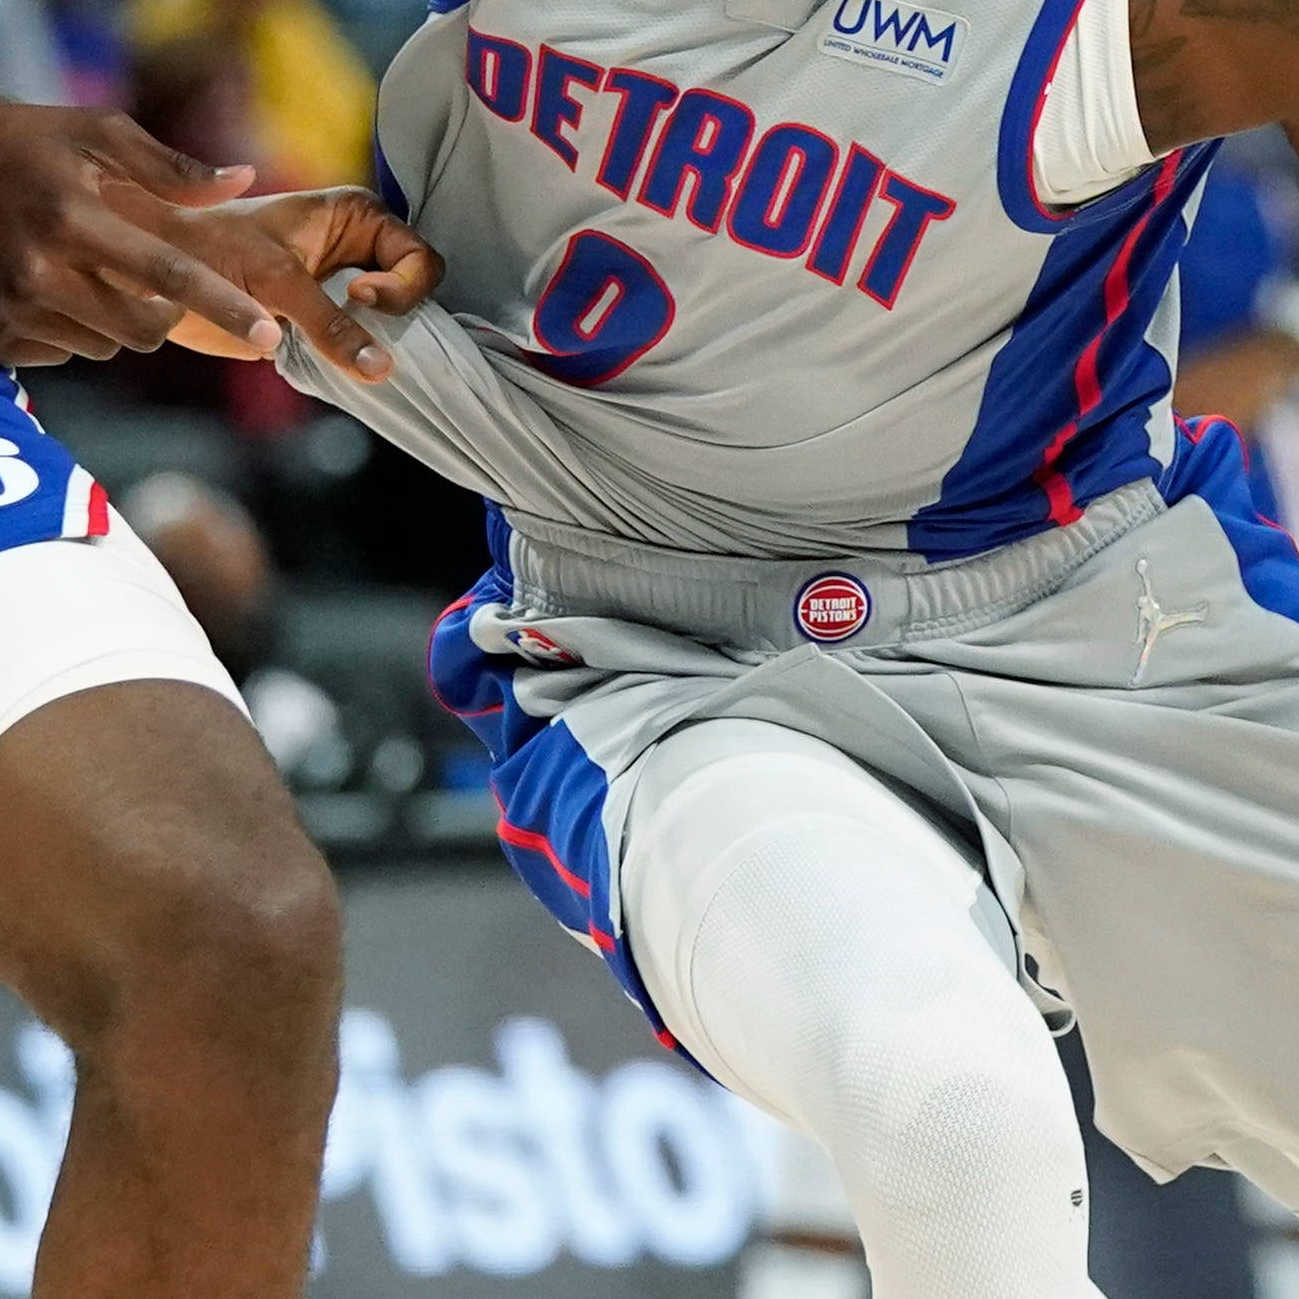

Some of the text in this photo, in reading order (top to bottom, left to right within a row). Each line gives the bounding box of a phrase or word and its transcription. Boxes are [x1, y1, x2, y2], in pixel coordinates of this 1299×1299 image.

[466, 24, 957, 310] DETROIT
[809, 596, 857, 610] DETROIT
[809, 608, 857, 623] PISTONS
